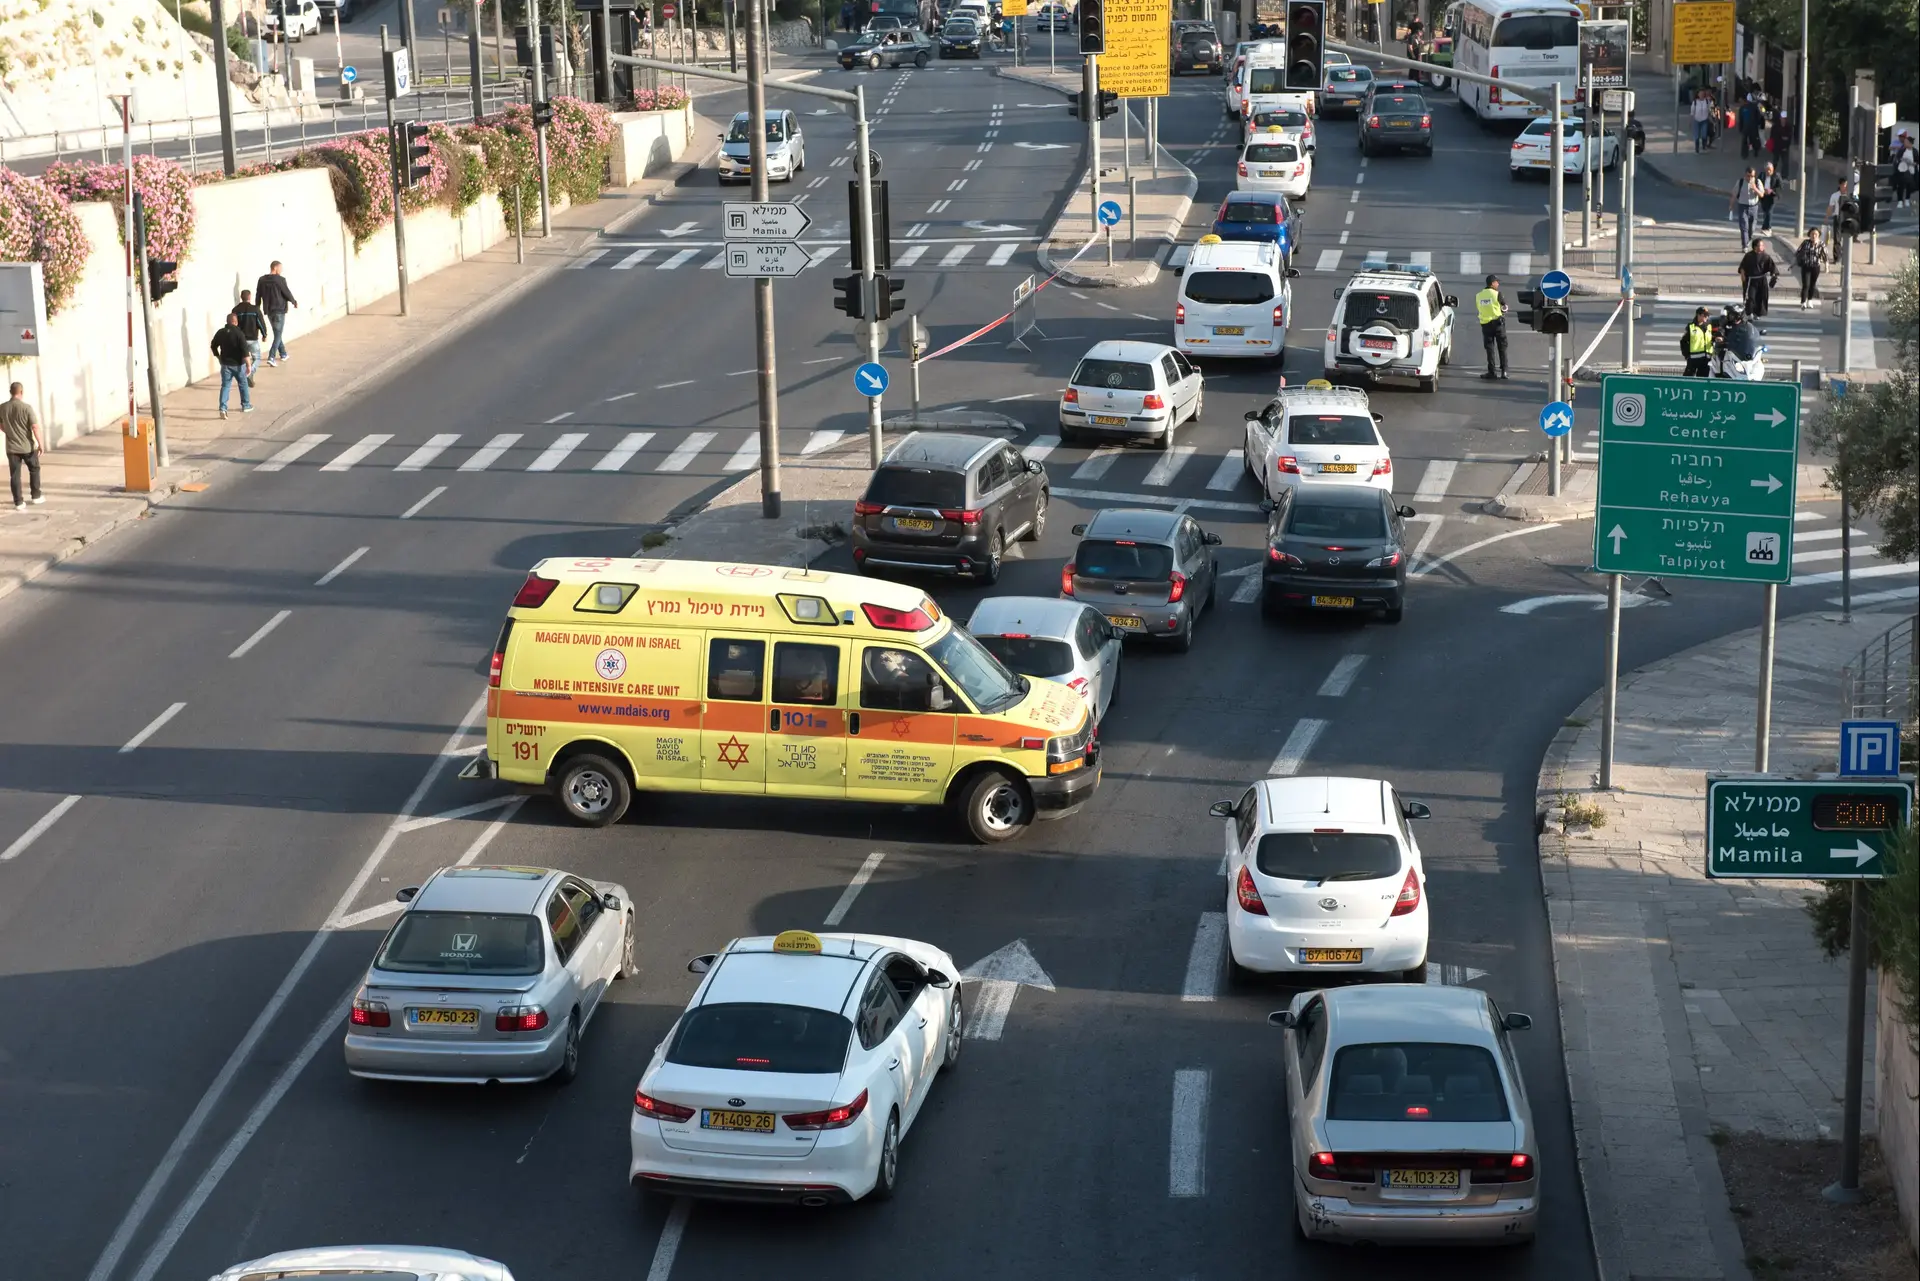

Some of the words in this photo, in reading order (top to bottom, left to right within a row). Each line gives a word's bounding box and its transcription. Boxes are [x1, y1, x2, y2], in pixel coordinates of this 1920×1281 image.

[1106, 14, 1128, 24] לפניך
[1132, 14, 1157, 22] מחסום
[752, 205, 786, 215] ממילא
[756, 246, 786, 256] קרתא
[1654, 387, 1693, 401] העיר
[1704, 389, 1747, 404] מרכז
[1661, 409, 1703, 421] المدينة
[1708, 412, 1736, 424] مركز
[1670, 426, 1726, 439] Center
[1671, 453, 1724, 468] רחביה
[1660, 491, 1730, 507] Rehavya
[1662, 518, 1725, 534] תלפיות
[1660, 554, 1726, 570] Talpiyot
[647, 599, 681, 616] נמרץ
[688, 598, 724, 616] טיפול
[730, 604, 766, 618] ניידת
[535, 632, 570, 644] MAGEN
[572, 634, 601, 646] DAVID
[604, 635, 634, 648] ADOM
[636, 636, 646, 648] IN
[649, 637, 682, 650] ISRAEL
[534, 678, 570, 691] MOBILE
[572, 680, 624, 694] INTENSIVE
[627, 683, 654, 695] CARE
[657, 684, 680, 696] UNIT
[578, 702, 670, 722] www.mdais.org
[784, 712, 813, 727] 101
[506, 722, 546, 736] ירושלים
[512, 740, 539, 760] 191
[782, 744, 798, 752] דוד
[778, 758, 816, 770] בישראל
[792, 752, 816, 761] אדום
[1724, 792, 1801, 813] ממילא
[1836, 802, 1886, 825] 800
[1734, 822, 1790, 841] ماميلا
[1719, 846, 1803, 864] Mamila
